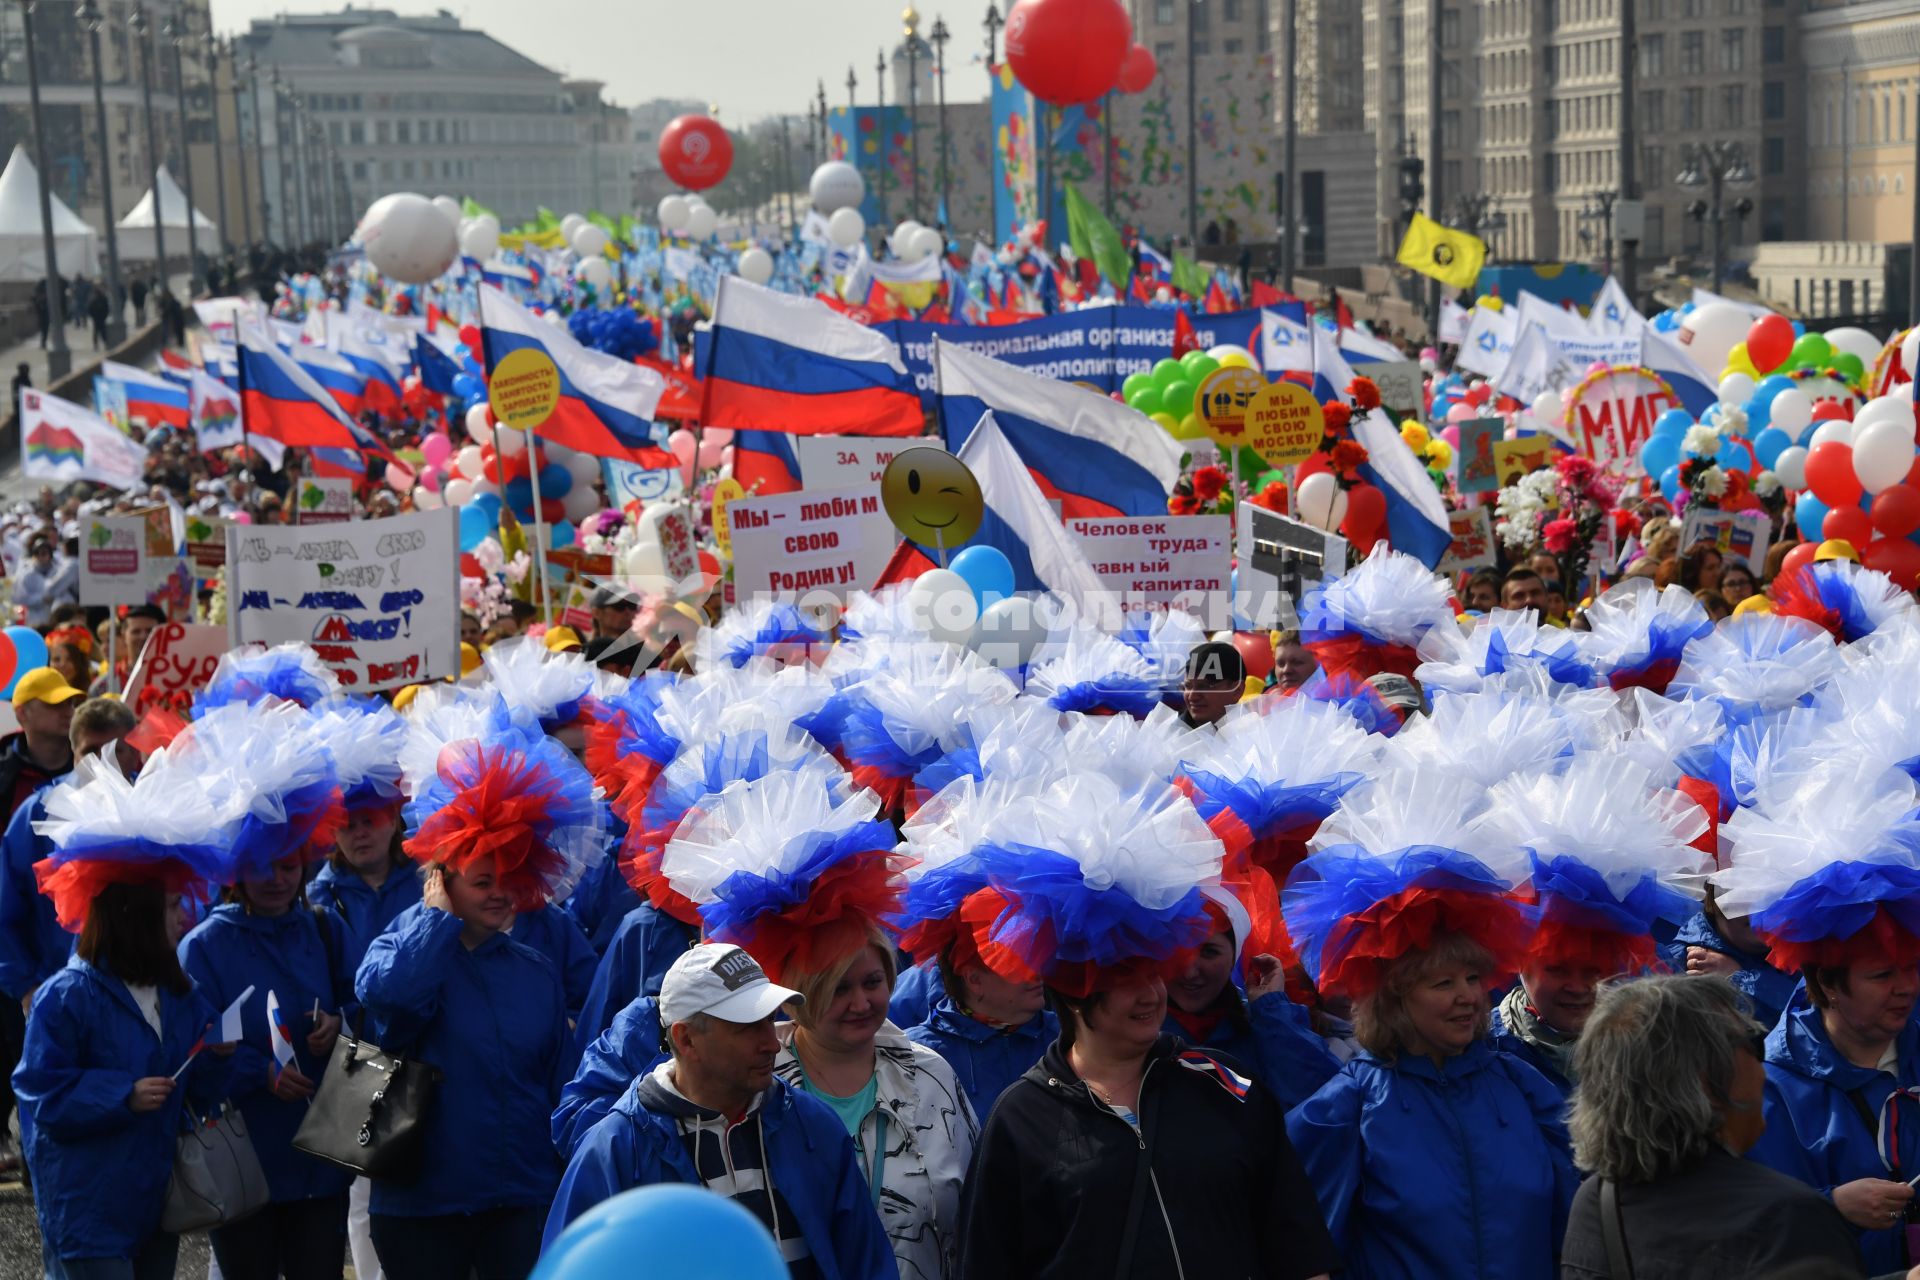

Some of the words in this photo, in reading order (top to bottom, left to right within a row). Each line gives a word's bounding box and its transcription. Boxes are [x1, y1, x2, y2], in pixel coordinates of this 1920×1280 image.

[1269, 394, 1294, 406] МЫ
[1255, 405, 1311, 422] ЛЮБИМ
[1263, 420, 1306, 435] СВОЮ
[1253, 432, 1319, 449] МОСКВУ!
[837, 452, 859, 465] ЗА
[733, 509, 769, 530] Мы
[1074, 521, 1167, 537] Человек
[784, 531, 840, 553] свою
[1149, 538, 1208, 553] труда
[1132, 578, 1220, 592] капитал
